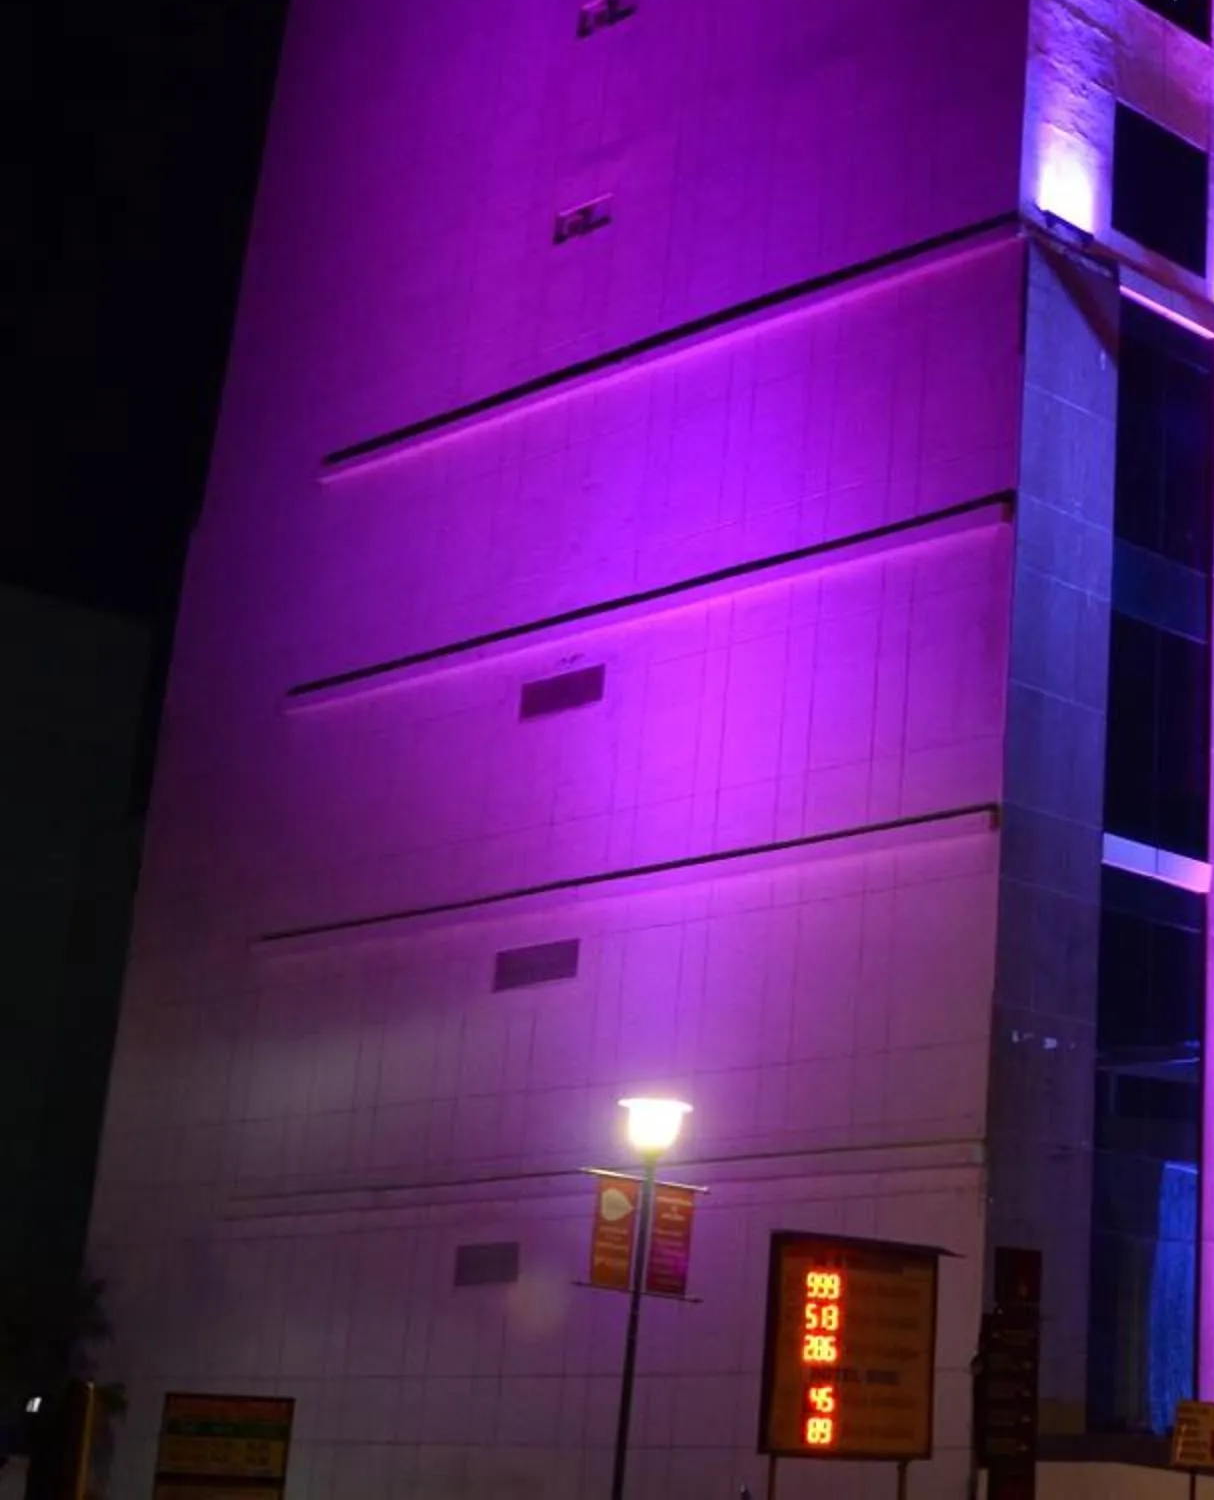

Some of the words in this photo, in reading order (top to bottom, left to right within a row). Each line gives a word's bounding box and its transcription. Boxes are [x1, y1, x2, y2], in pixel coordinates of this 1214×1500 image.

[807, 1272, 840, 1299] 999
[803, 1335, 836, 1362] 286
[810, 1387, 834, 1412] 45
[807, 1418, 832, 1443] 89
